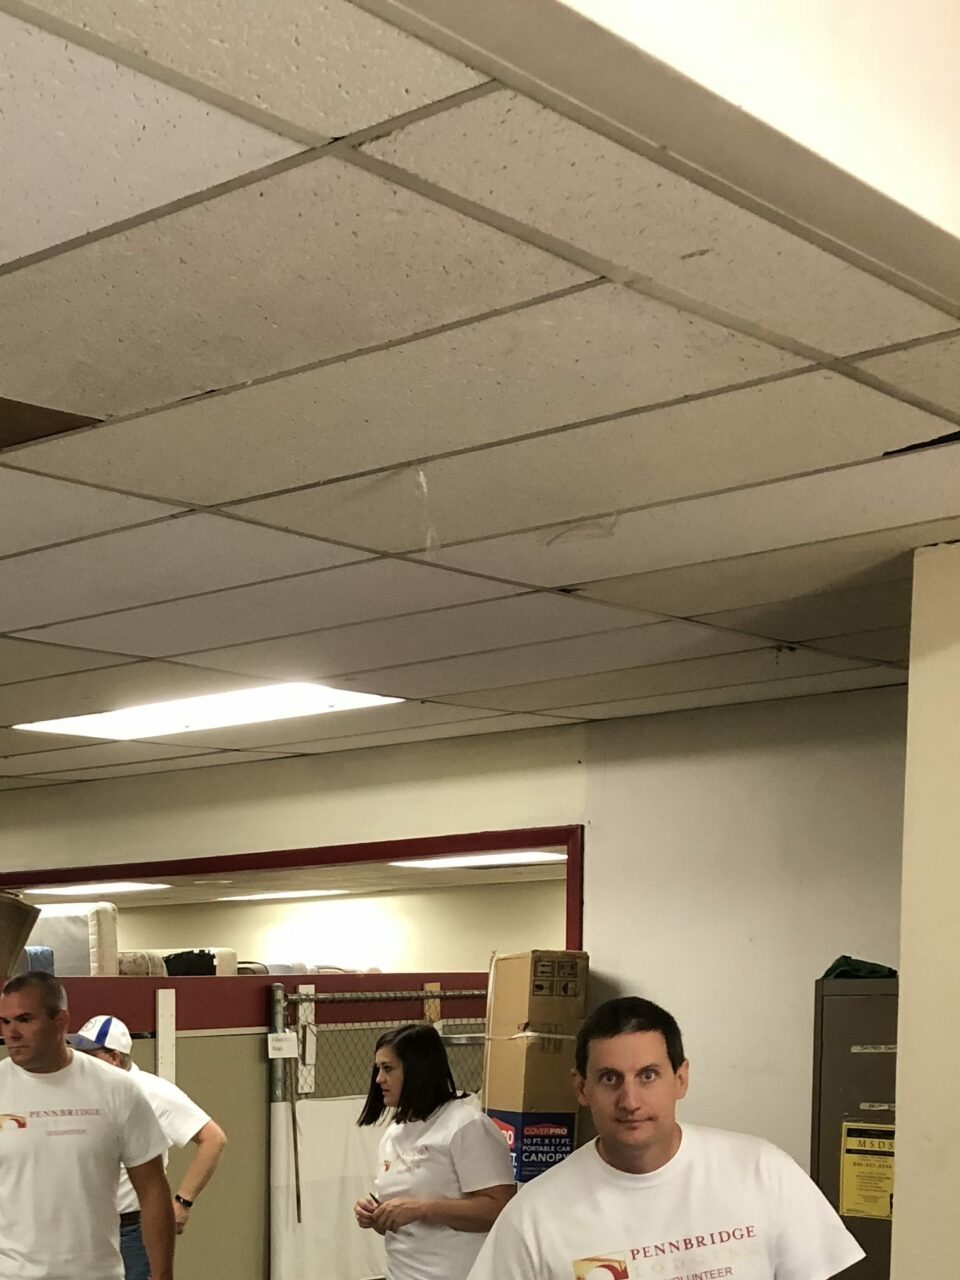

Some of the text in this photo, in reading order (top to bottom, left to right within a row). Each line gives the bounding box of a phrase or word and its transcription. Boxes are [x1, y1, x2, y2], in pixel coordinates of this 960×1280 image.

[29, 1108, 102, 1118] PENNBRIDGE
[524, 1127, 568, 1136] COVERPRO
[630, 1225, 757, 1261] PENNBRIDGE
